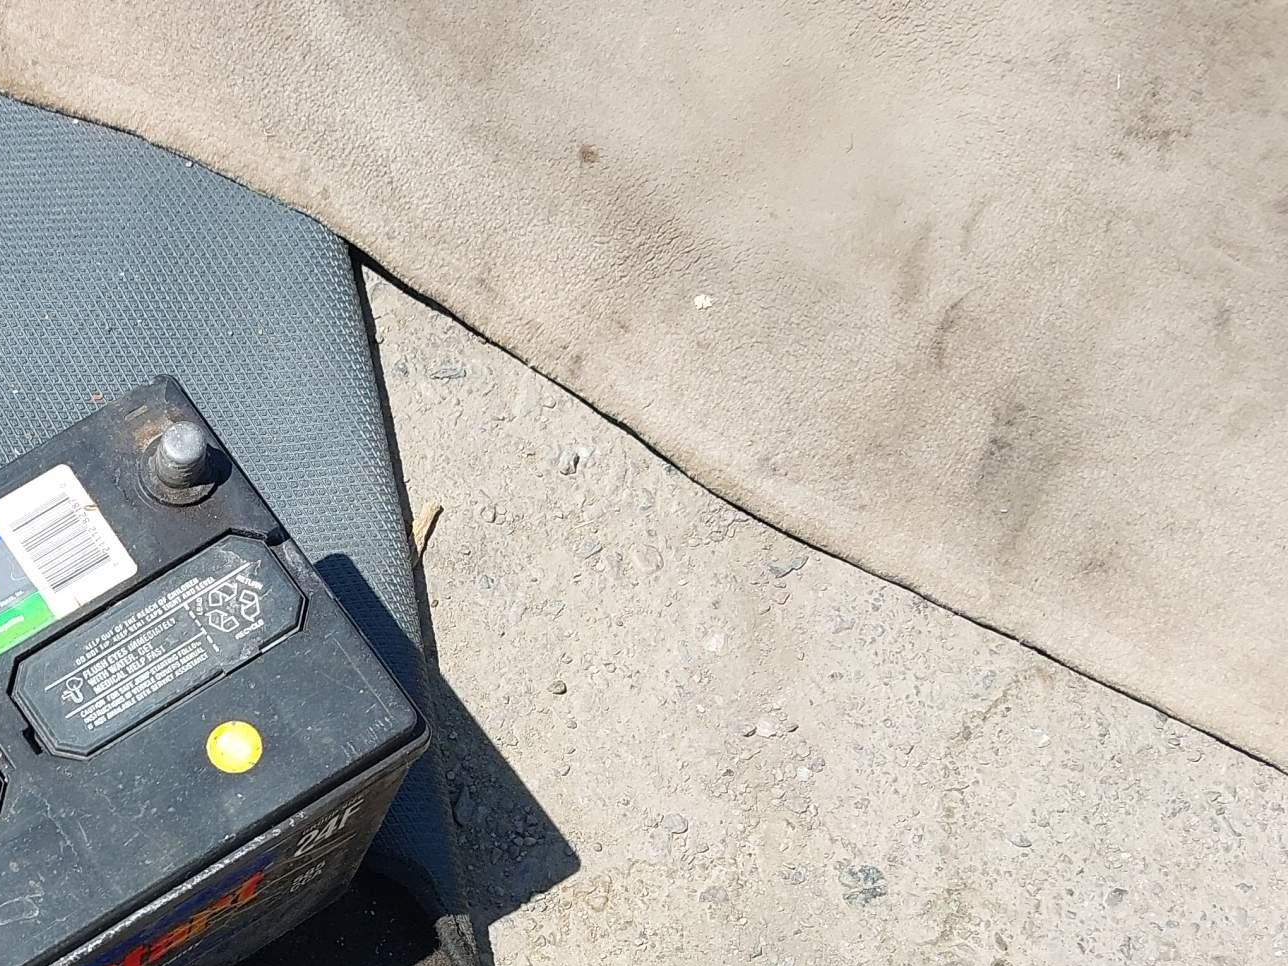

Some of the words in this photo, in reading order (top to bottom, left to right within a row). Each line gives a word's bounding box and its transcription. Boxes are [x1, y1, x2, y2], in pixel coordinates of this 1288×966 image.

[144, 607, 163, 622] CAPS
[233, 618, 265, 640] RECYCLE
[81, 658, 109, 679] FLUSH
[106, 646, 128, 664] EYES
[126, 616, 177, 652] IMMEDIATELY
[87, 668, 110, 687] WITH
[136, 642, 153, 656] GET
[92, 669, 128, 694] MEDICAL
[125, 656, 147, 674] HELP
[145, 645, 166, 661] FAST
[294, 798, 365, 857] 24F
